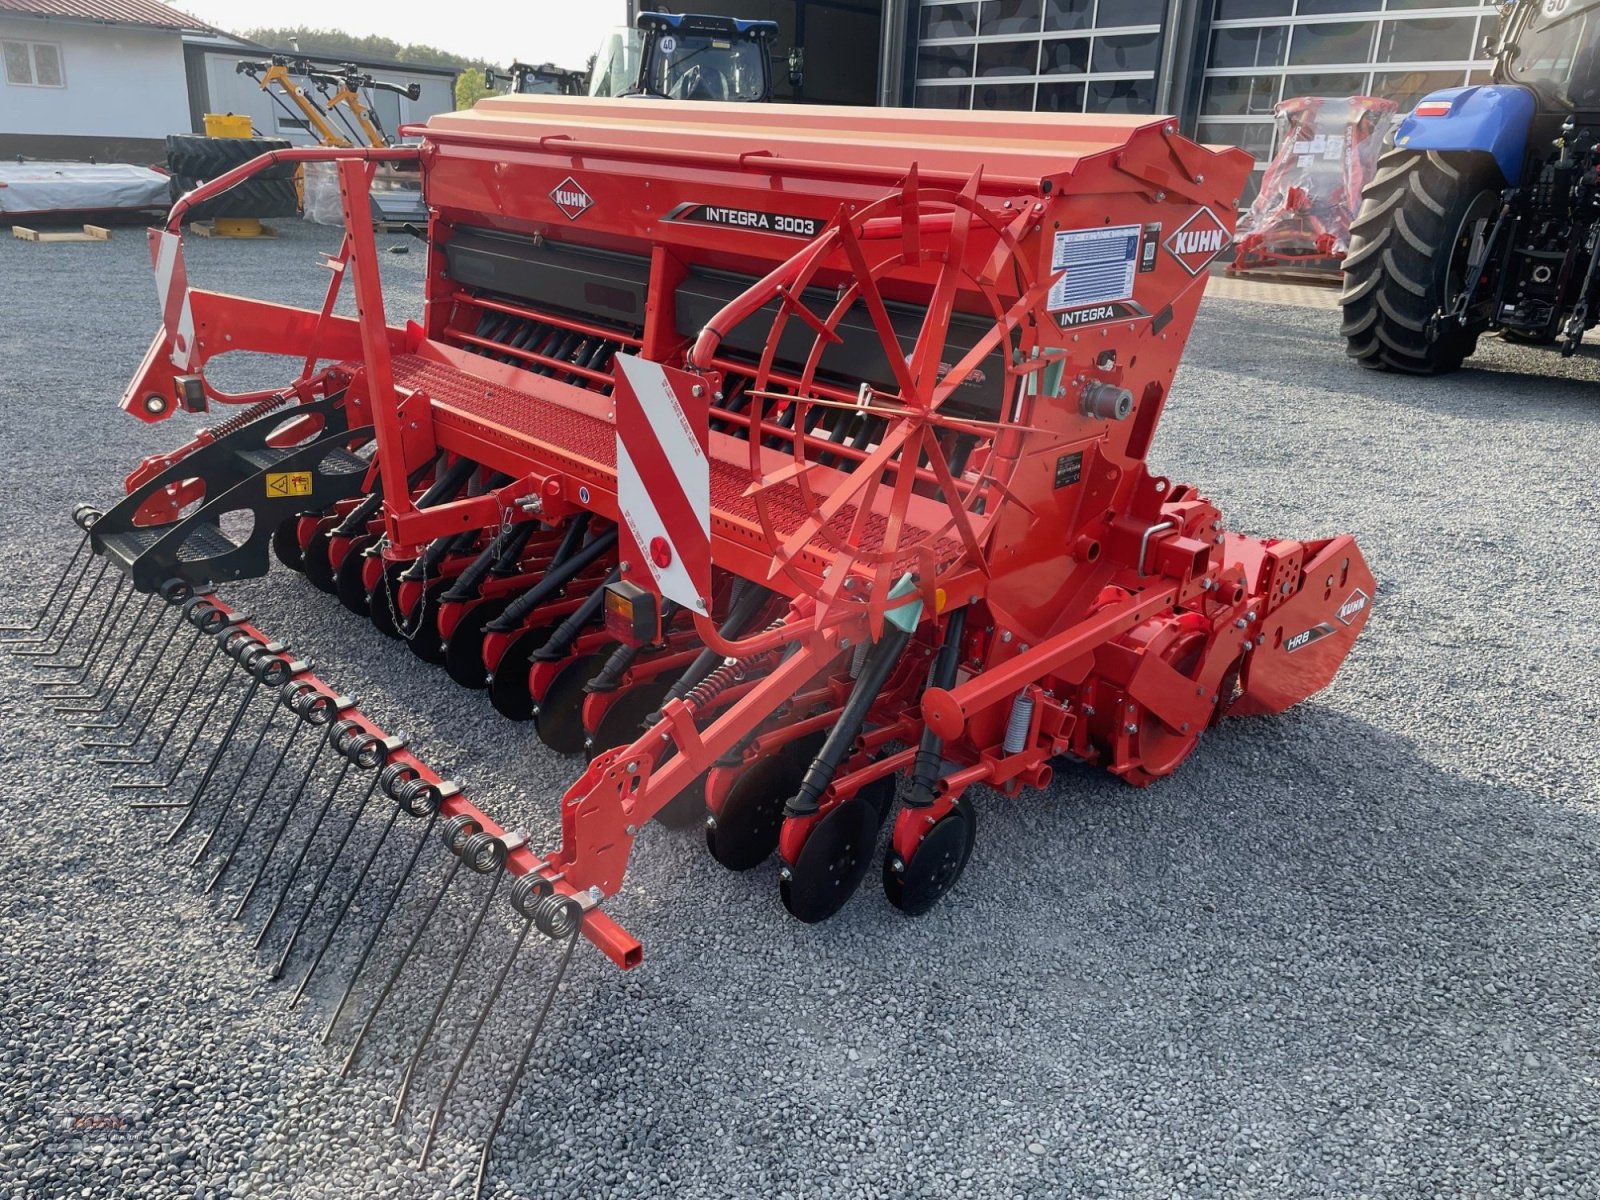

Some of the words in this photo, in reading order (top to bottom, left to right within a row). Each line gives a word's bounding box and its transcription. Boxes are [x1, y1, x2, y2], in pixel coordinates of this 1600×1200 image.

[663, 40, 673, 50] 40
[556, 190, 586, 208] KUHN
[706, 207, 769, 229] INTEGRA
[774, 216, 815, 235] 3003
[1175, 229, 1224, 254] KUHN
[1061, 305, 1114, 326] INTEGRA
[1340, 597, 1366, 618] KUHN
